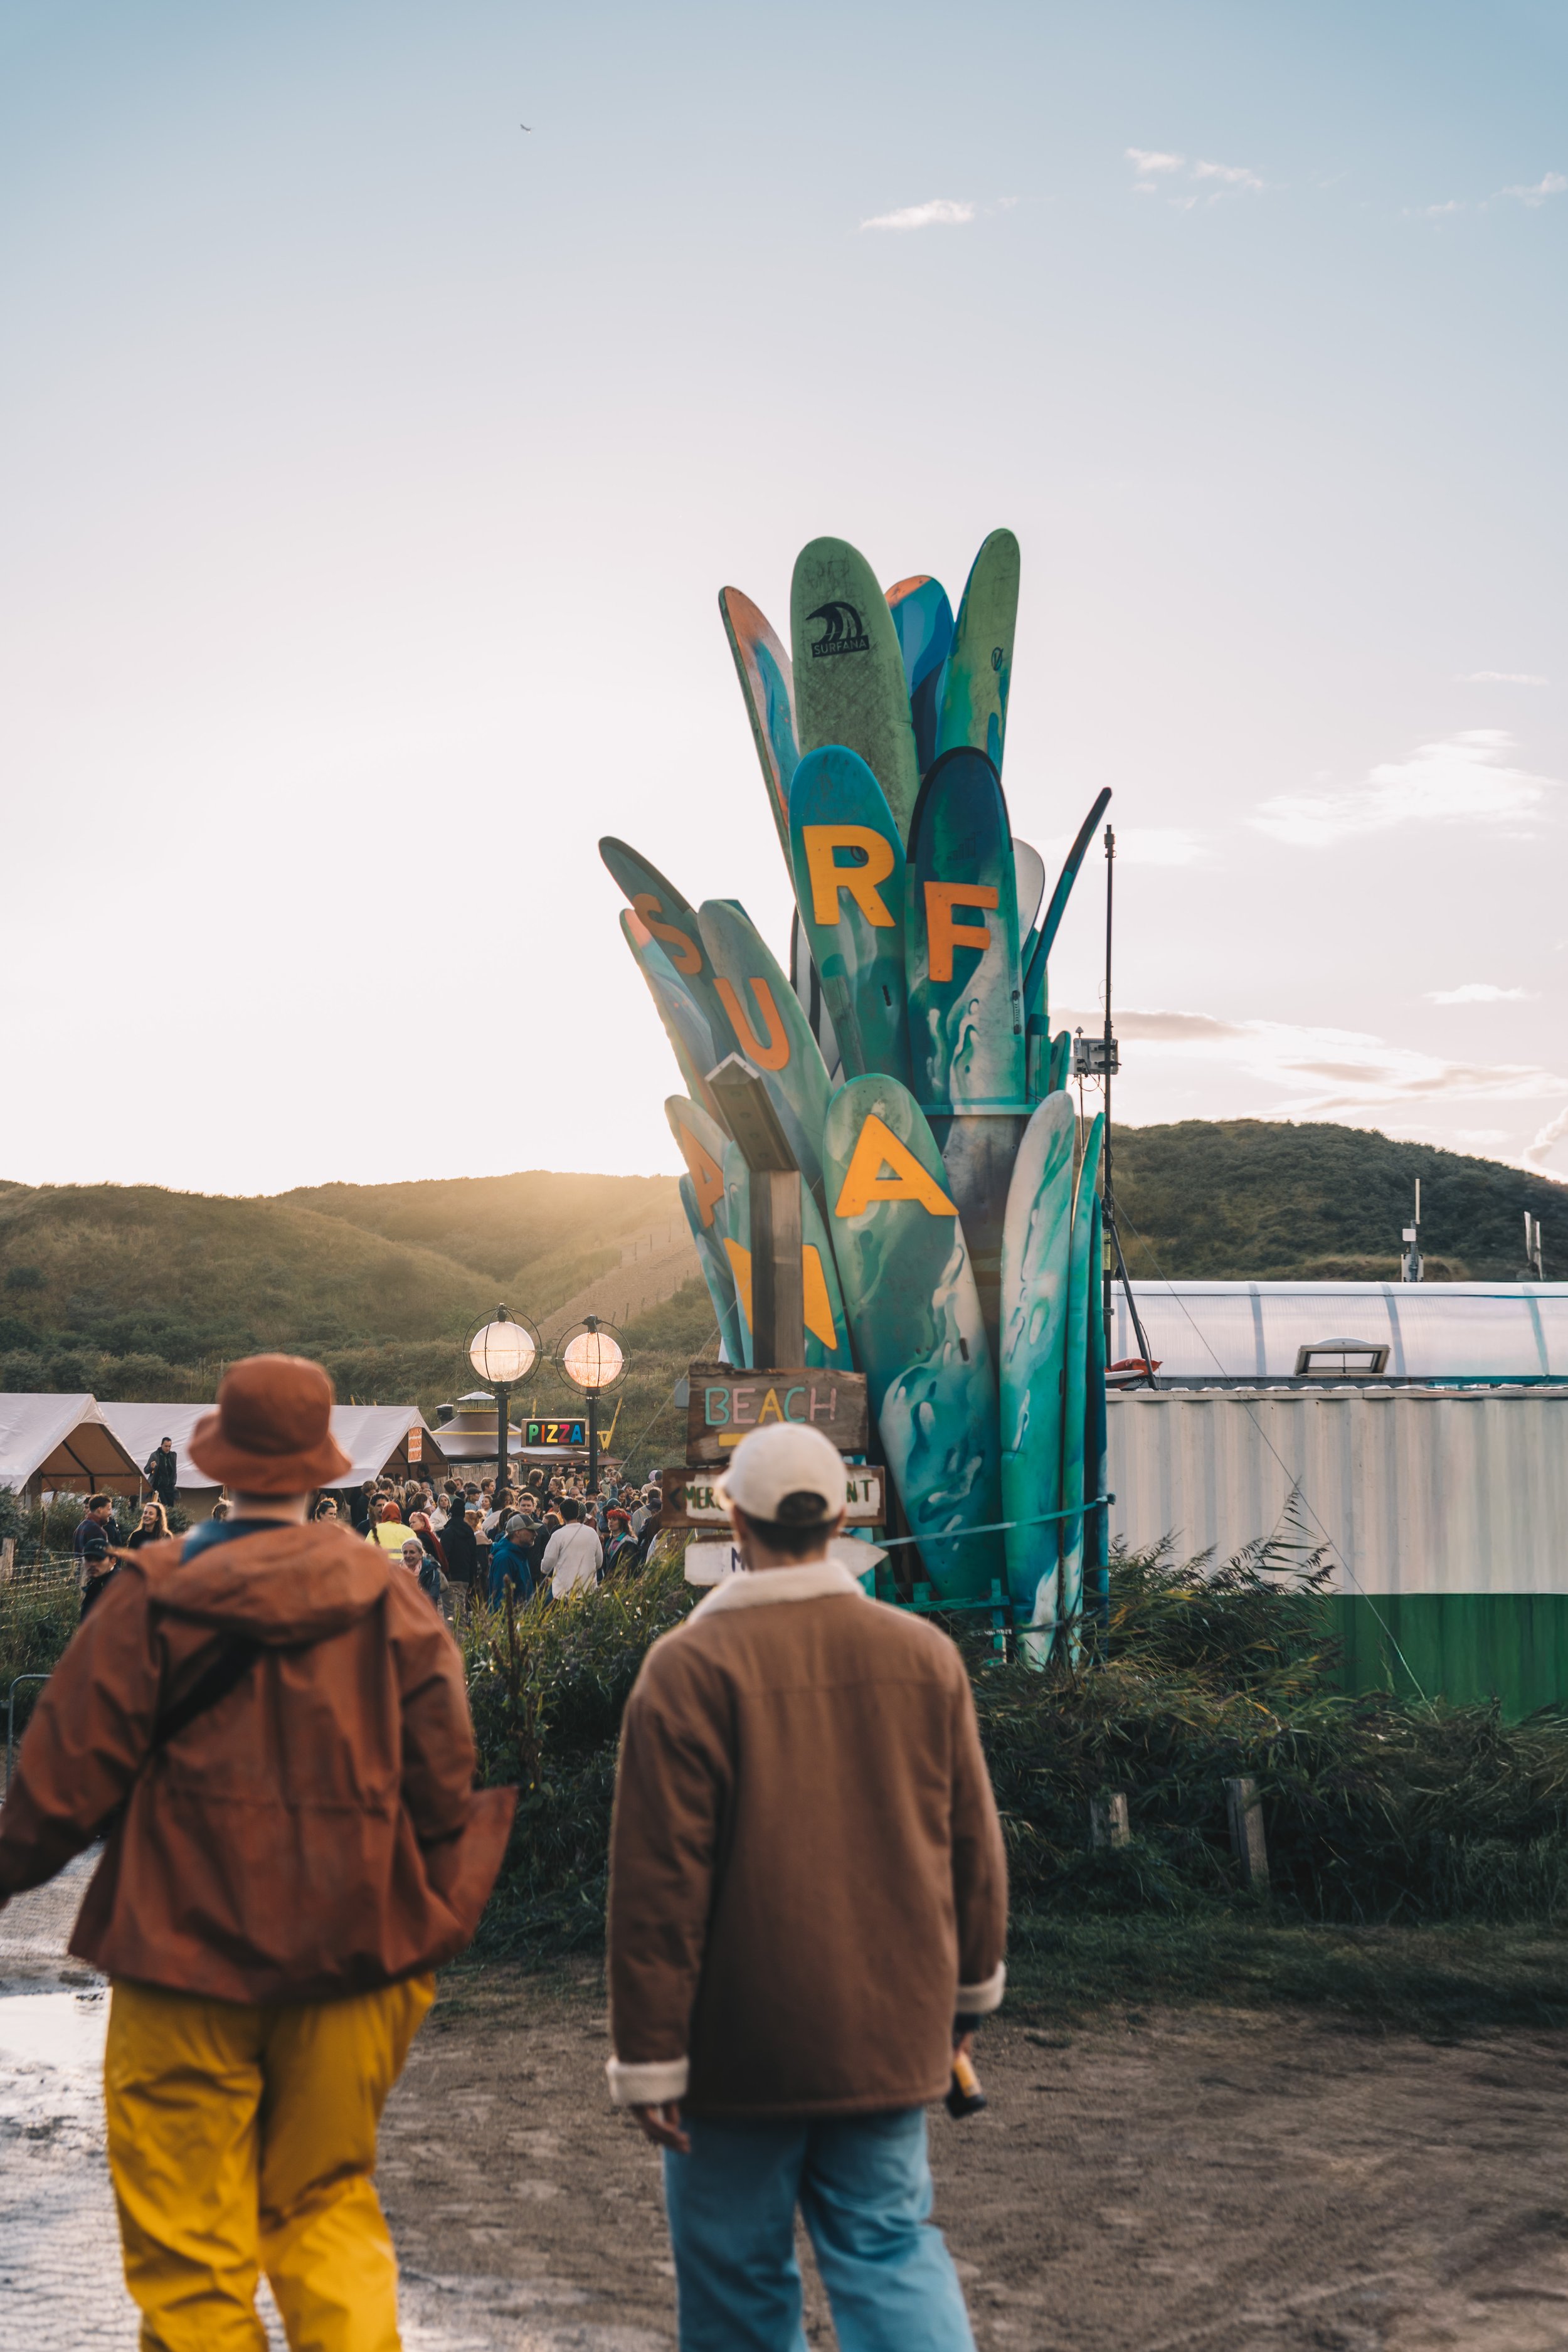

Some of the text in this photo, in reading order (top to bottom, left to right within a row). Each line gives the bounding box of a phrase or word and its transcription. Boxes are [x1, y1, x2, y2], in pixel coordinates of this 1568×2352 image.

[813, 638, 867, 655] SURFANA
[705, 1387, 837, 1425] BEACH
[529, 1424, 583, 1443] PIZZA
